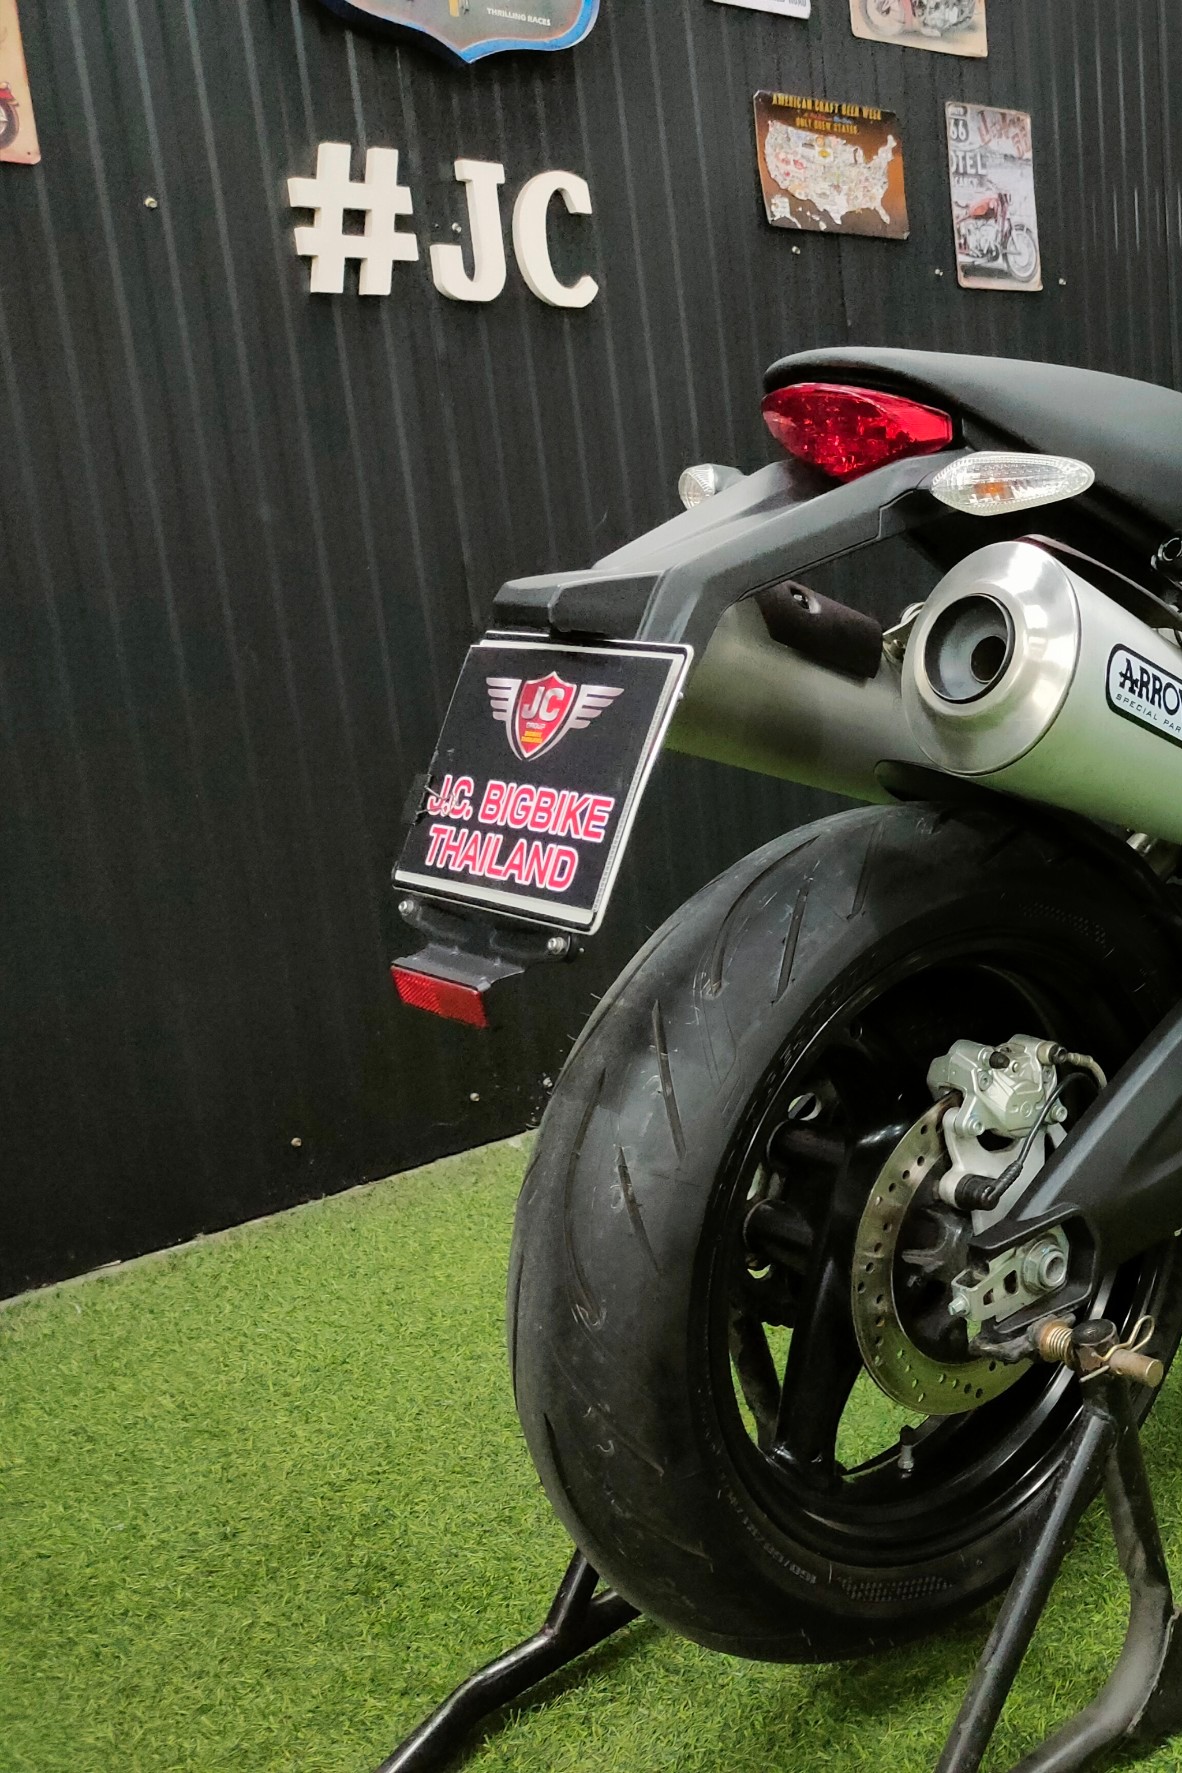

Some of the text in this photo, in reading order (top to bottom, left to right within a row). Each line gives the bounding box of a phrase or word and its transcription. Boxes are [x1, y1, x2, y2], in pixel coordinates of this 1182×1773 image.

[771, 93, 813, 110] AMERICAN
[815, 98, 839, 114] CRAFT
[841, 103, 859, 118] BEER
[950, 118, 968, 141] 66
[286, 142, 599, 309] #JC
[520, 686, 565, 721] JC
[1114, 693, 1158, 721] SPECIAL
[426, 773, 616, 844] J.C. BIGBIKE
[425, 824, 579, 893] THAILAND
